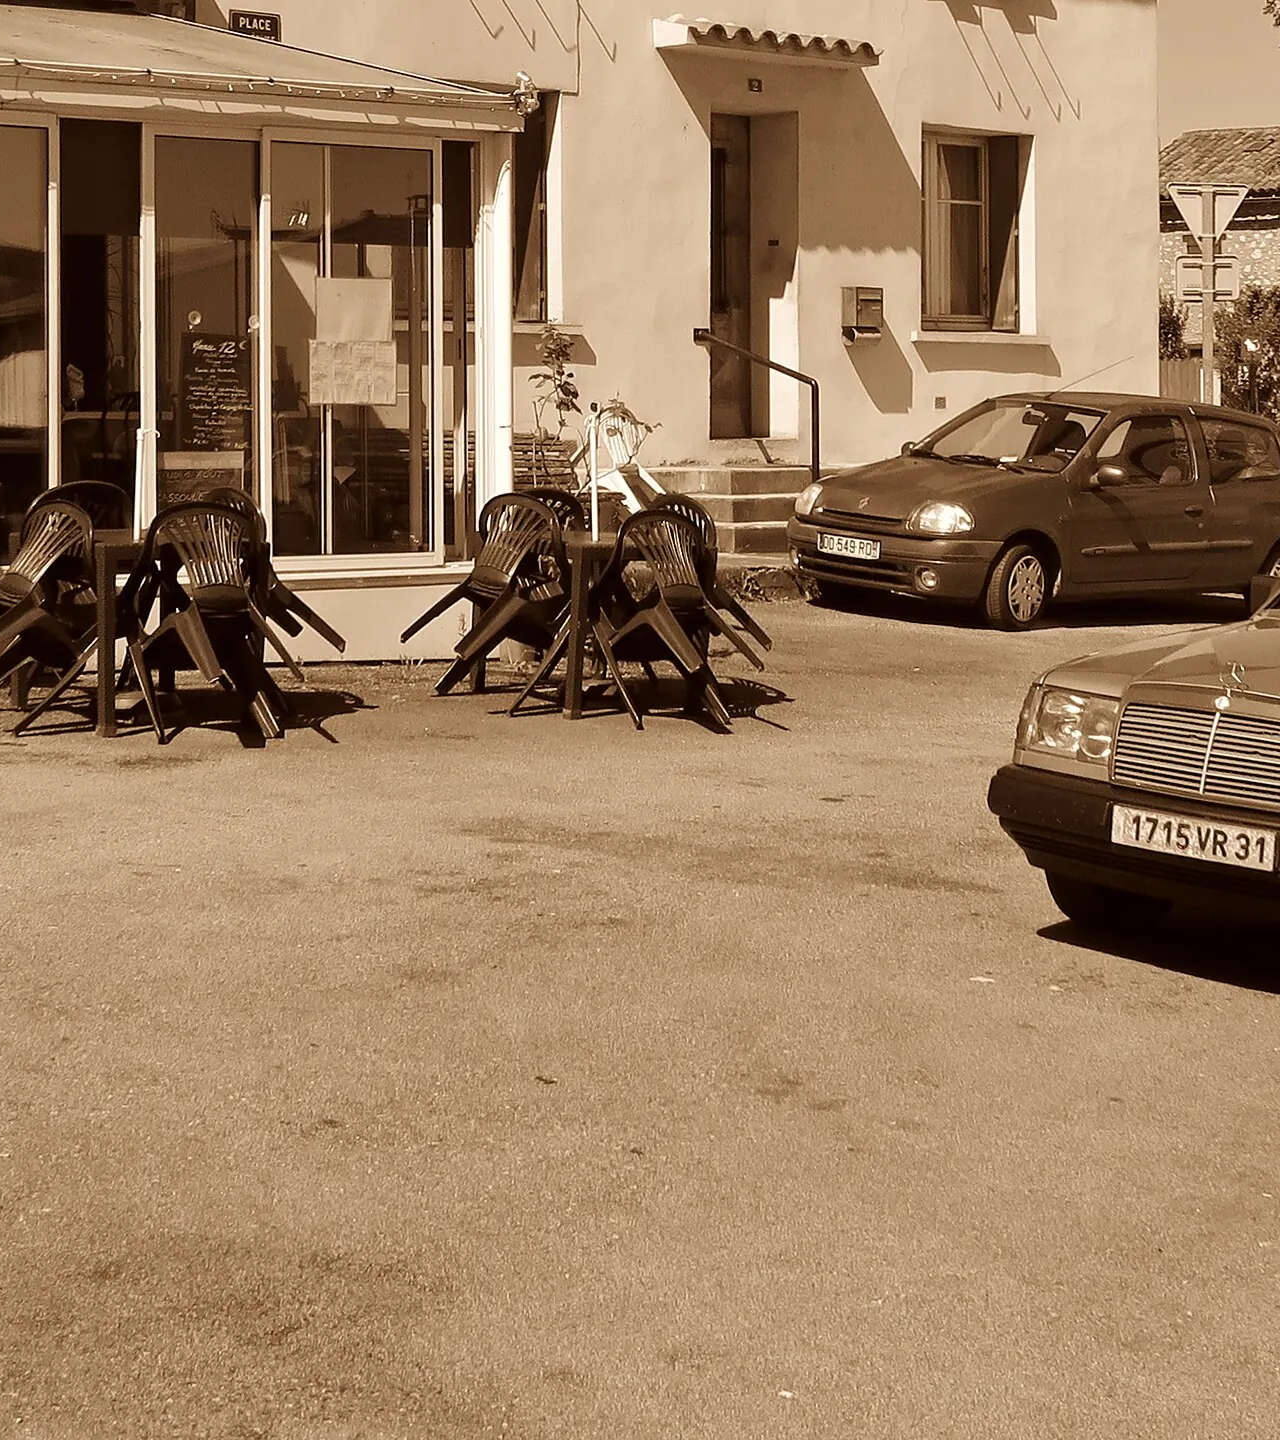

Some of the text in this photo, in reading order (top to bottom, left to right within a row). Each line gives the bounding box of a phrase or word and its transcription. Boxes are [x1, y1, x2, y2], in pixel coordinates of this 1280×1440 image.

[239, 16, 271, 31] PLACE
[751, 80, 759, 91] 2
[219, 340, 236, 354] 12
[1131, 814, 1266, 864] 1715 VR 31
